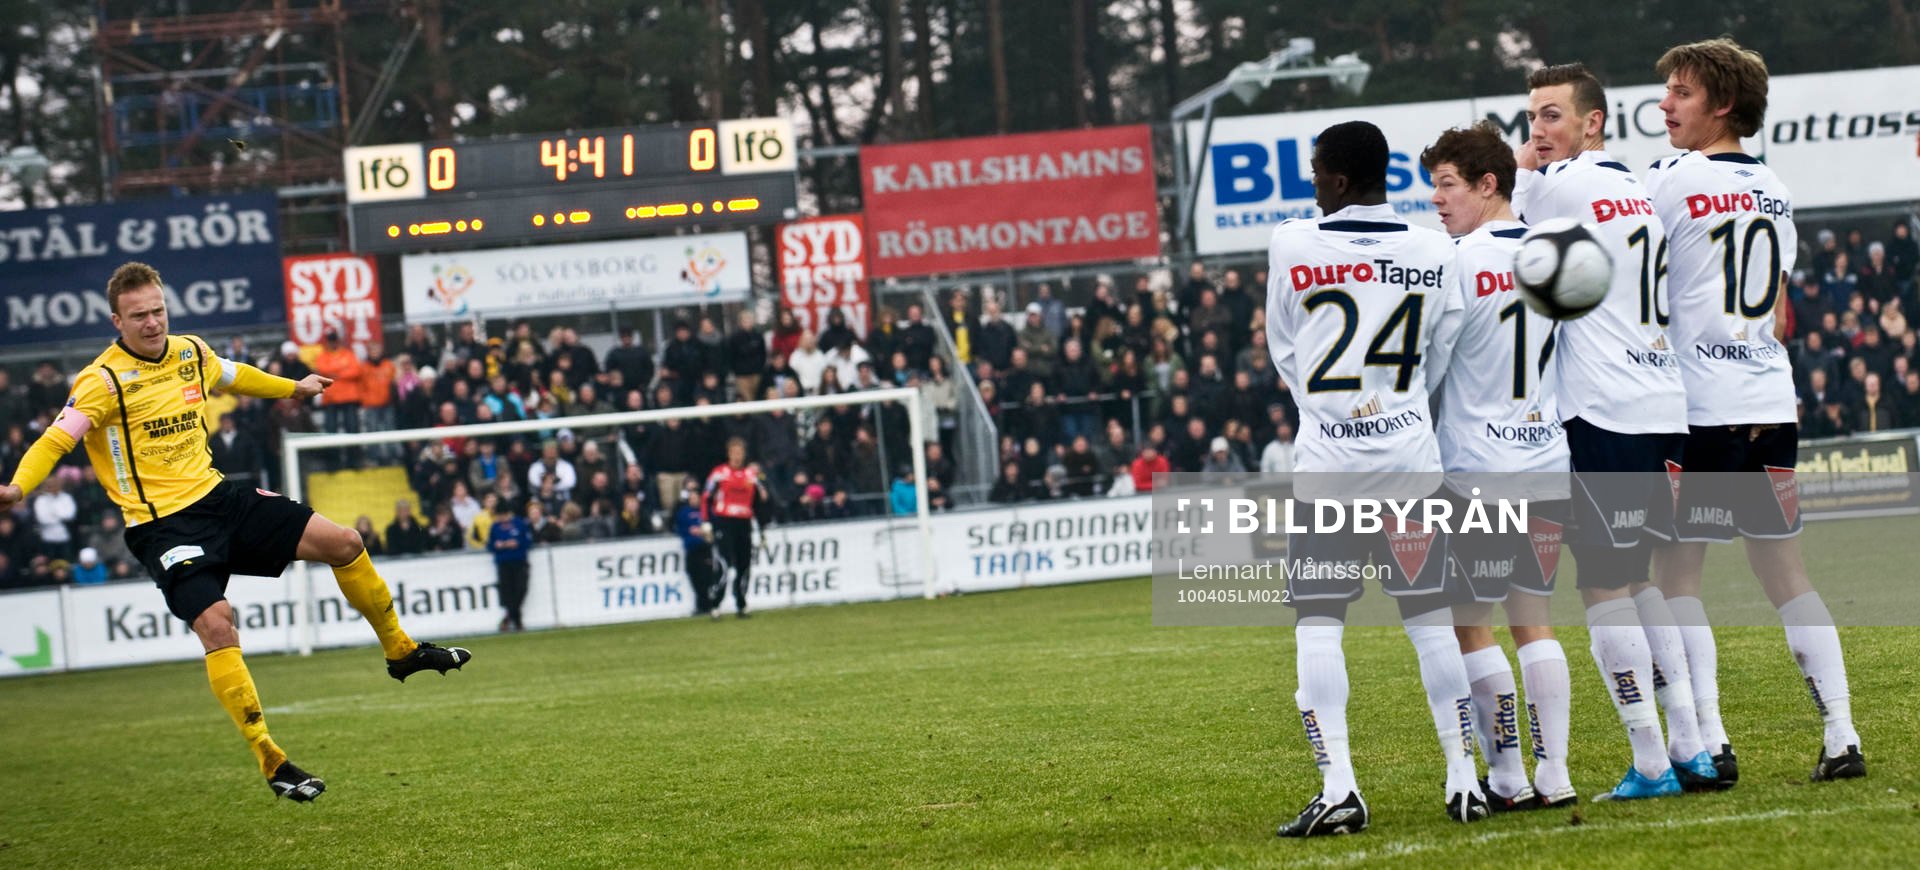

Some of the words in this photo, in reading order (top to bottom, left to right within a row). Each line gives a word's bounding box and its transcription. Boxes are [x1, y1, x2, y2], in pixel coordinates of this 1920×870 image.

[429, 148, 455, 190] 0
[689, 129, 716, 172] 0
[872, 147, 1144, 194] KARLSHAMNS
[117, 219, 157, 253] &
[167, 202, 273, 249] RÖR
[781, 220, 862, 265] SYD
[877, 211, 1150, 259] RÖRMONTAGE
[290, 257, 374, 304] SYD
[1290, 259, 1443, 292] Duro.Tapet
[1628, 224, 1670, 327] 16
[1710, 217, 1781, 319] 10
[6, 278, 254, 330] MONAGE
[1302, 288, 1425, 394] 24
[143, 417, 170, 431] STÅL
[149, 420, 198, 439] MONTAGE
[1320, 408, 1423, 440] NORRPORTEN
[968, 505, 1205, 548] SCANDINAVIAN
[973, 550, 1053, 576] TANK
[1064, 535, 1207, 569] STORAGE
[602, 580, 682, 608] TANK
[1495, 692, 1519, 754] Tvättex
